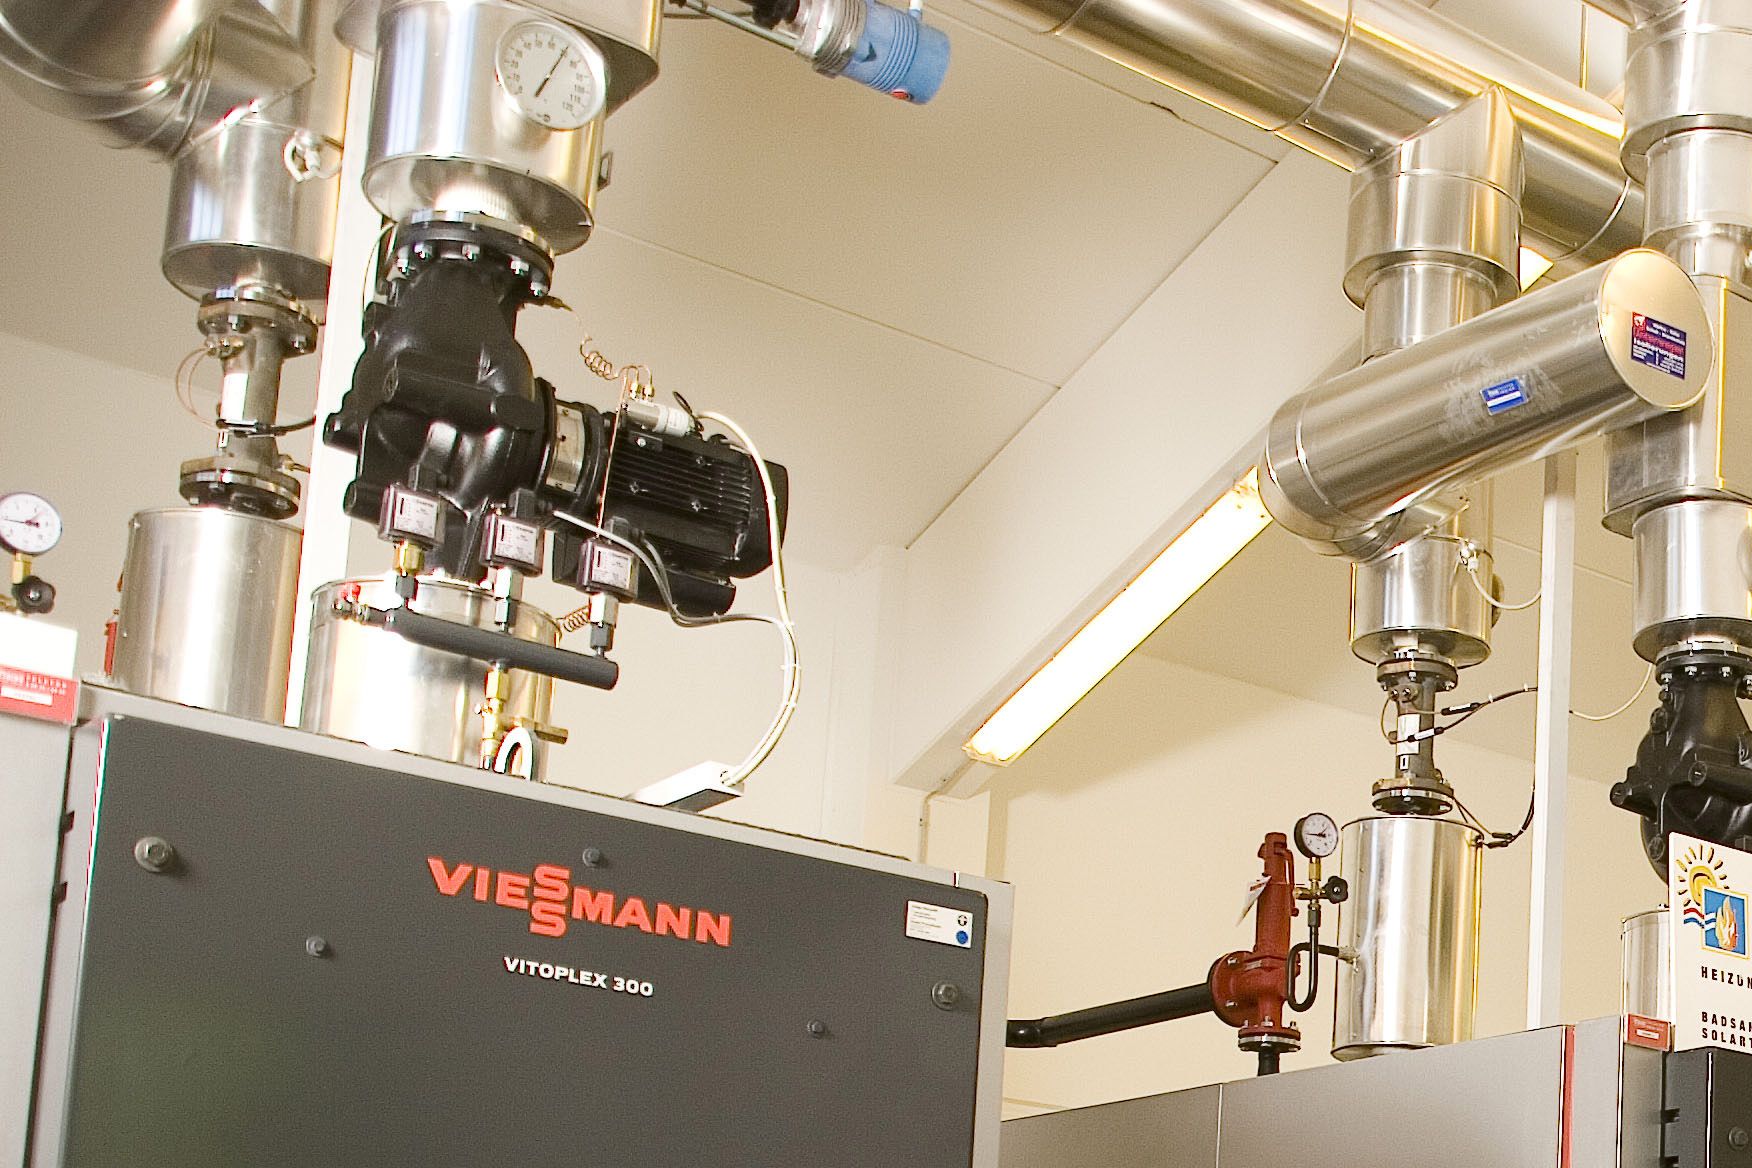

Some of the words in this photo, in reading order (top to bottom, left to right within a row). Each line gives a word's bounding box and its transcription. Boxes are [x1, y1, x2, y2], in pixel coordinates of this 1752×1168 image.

[427, 856, 733, 948] VIESSMANN
[503, 956, 608, 990] VITOPLEX
[613, 976, 655, 997] 300
